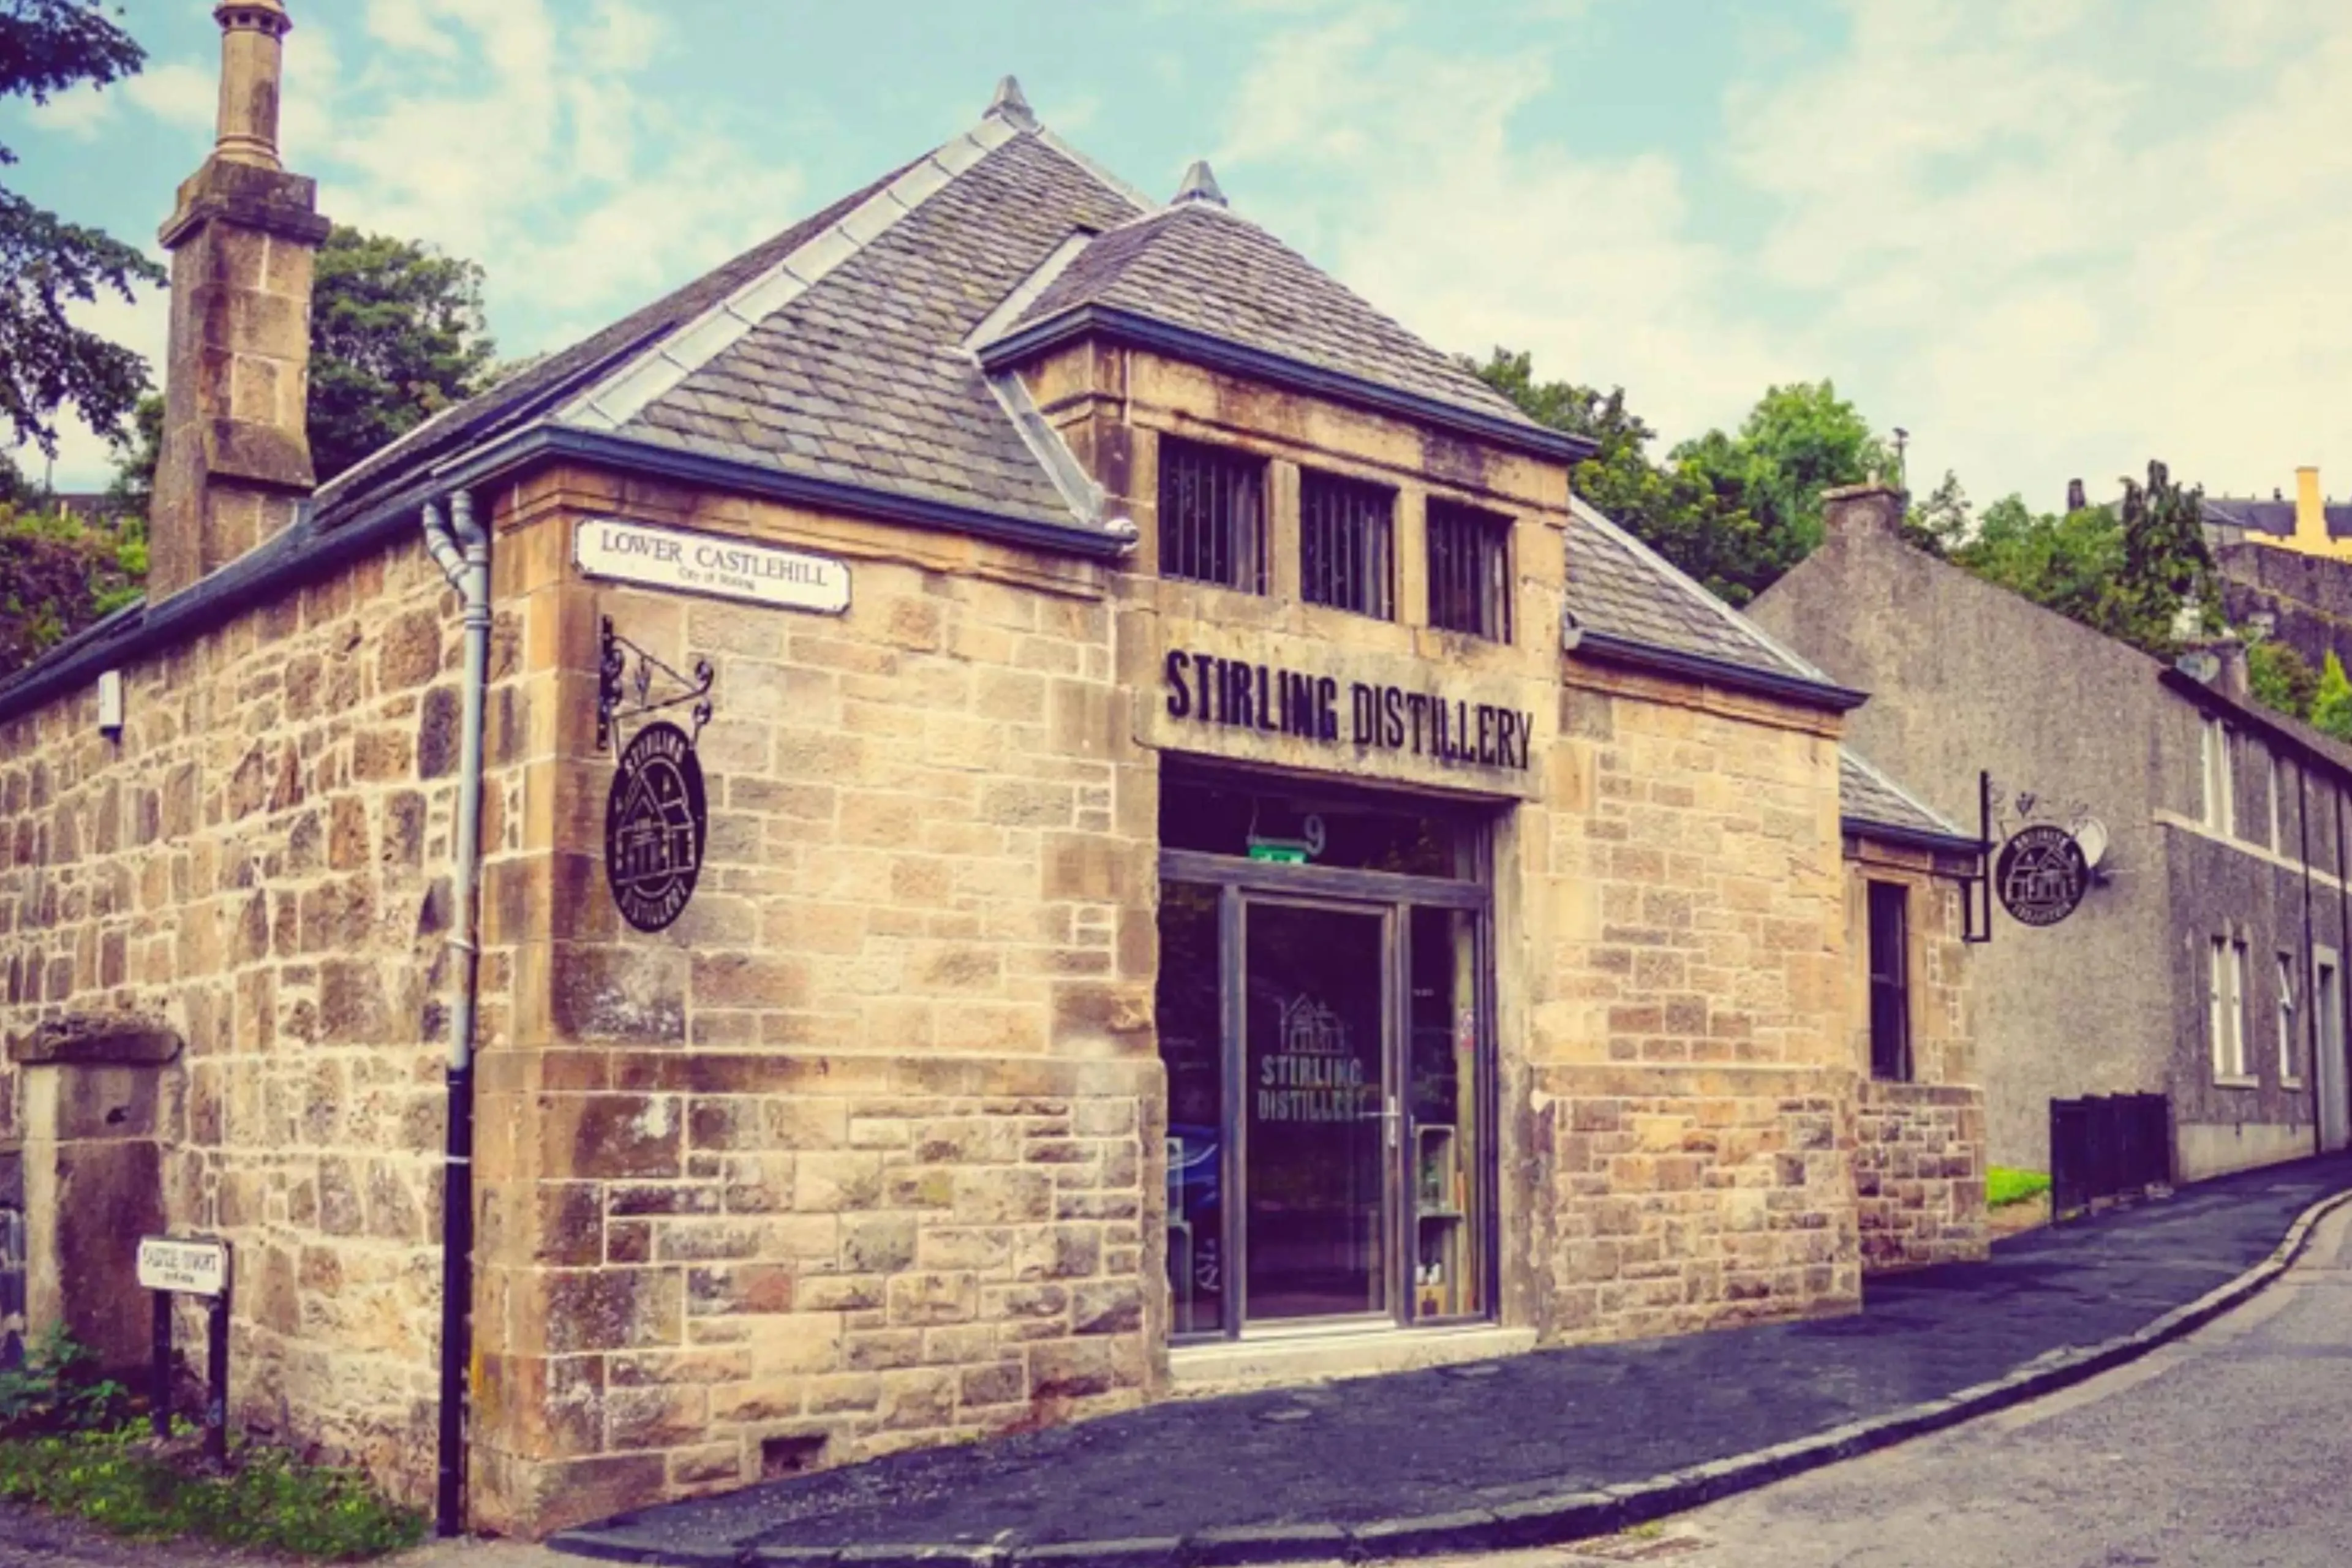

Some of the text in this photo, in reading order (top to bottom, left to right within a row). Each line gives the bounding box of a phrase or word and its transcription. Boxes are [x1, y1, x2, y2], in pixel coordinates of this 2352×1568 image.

[601, 529, 682, 565] LOWER
[694, 545, 828, 586] CASTLEHILL
[1167, 648, 1533, 770] STIRLING DISTILLERY
[1304, 815, 1325, 856] 9
